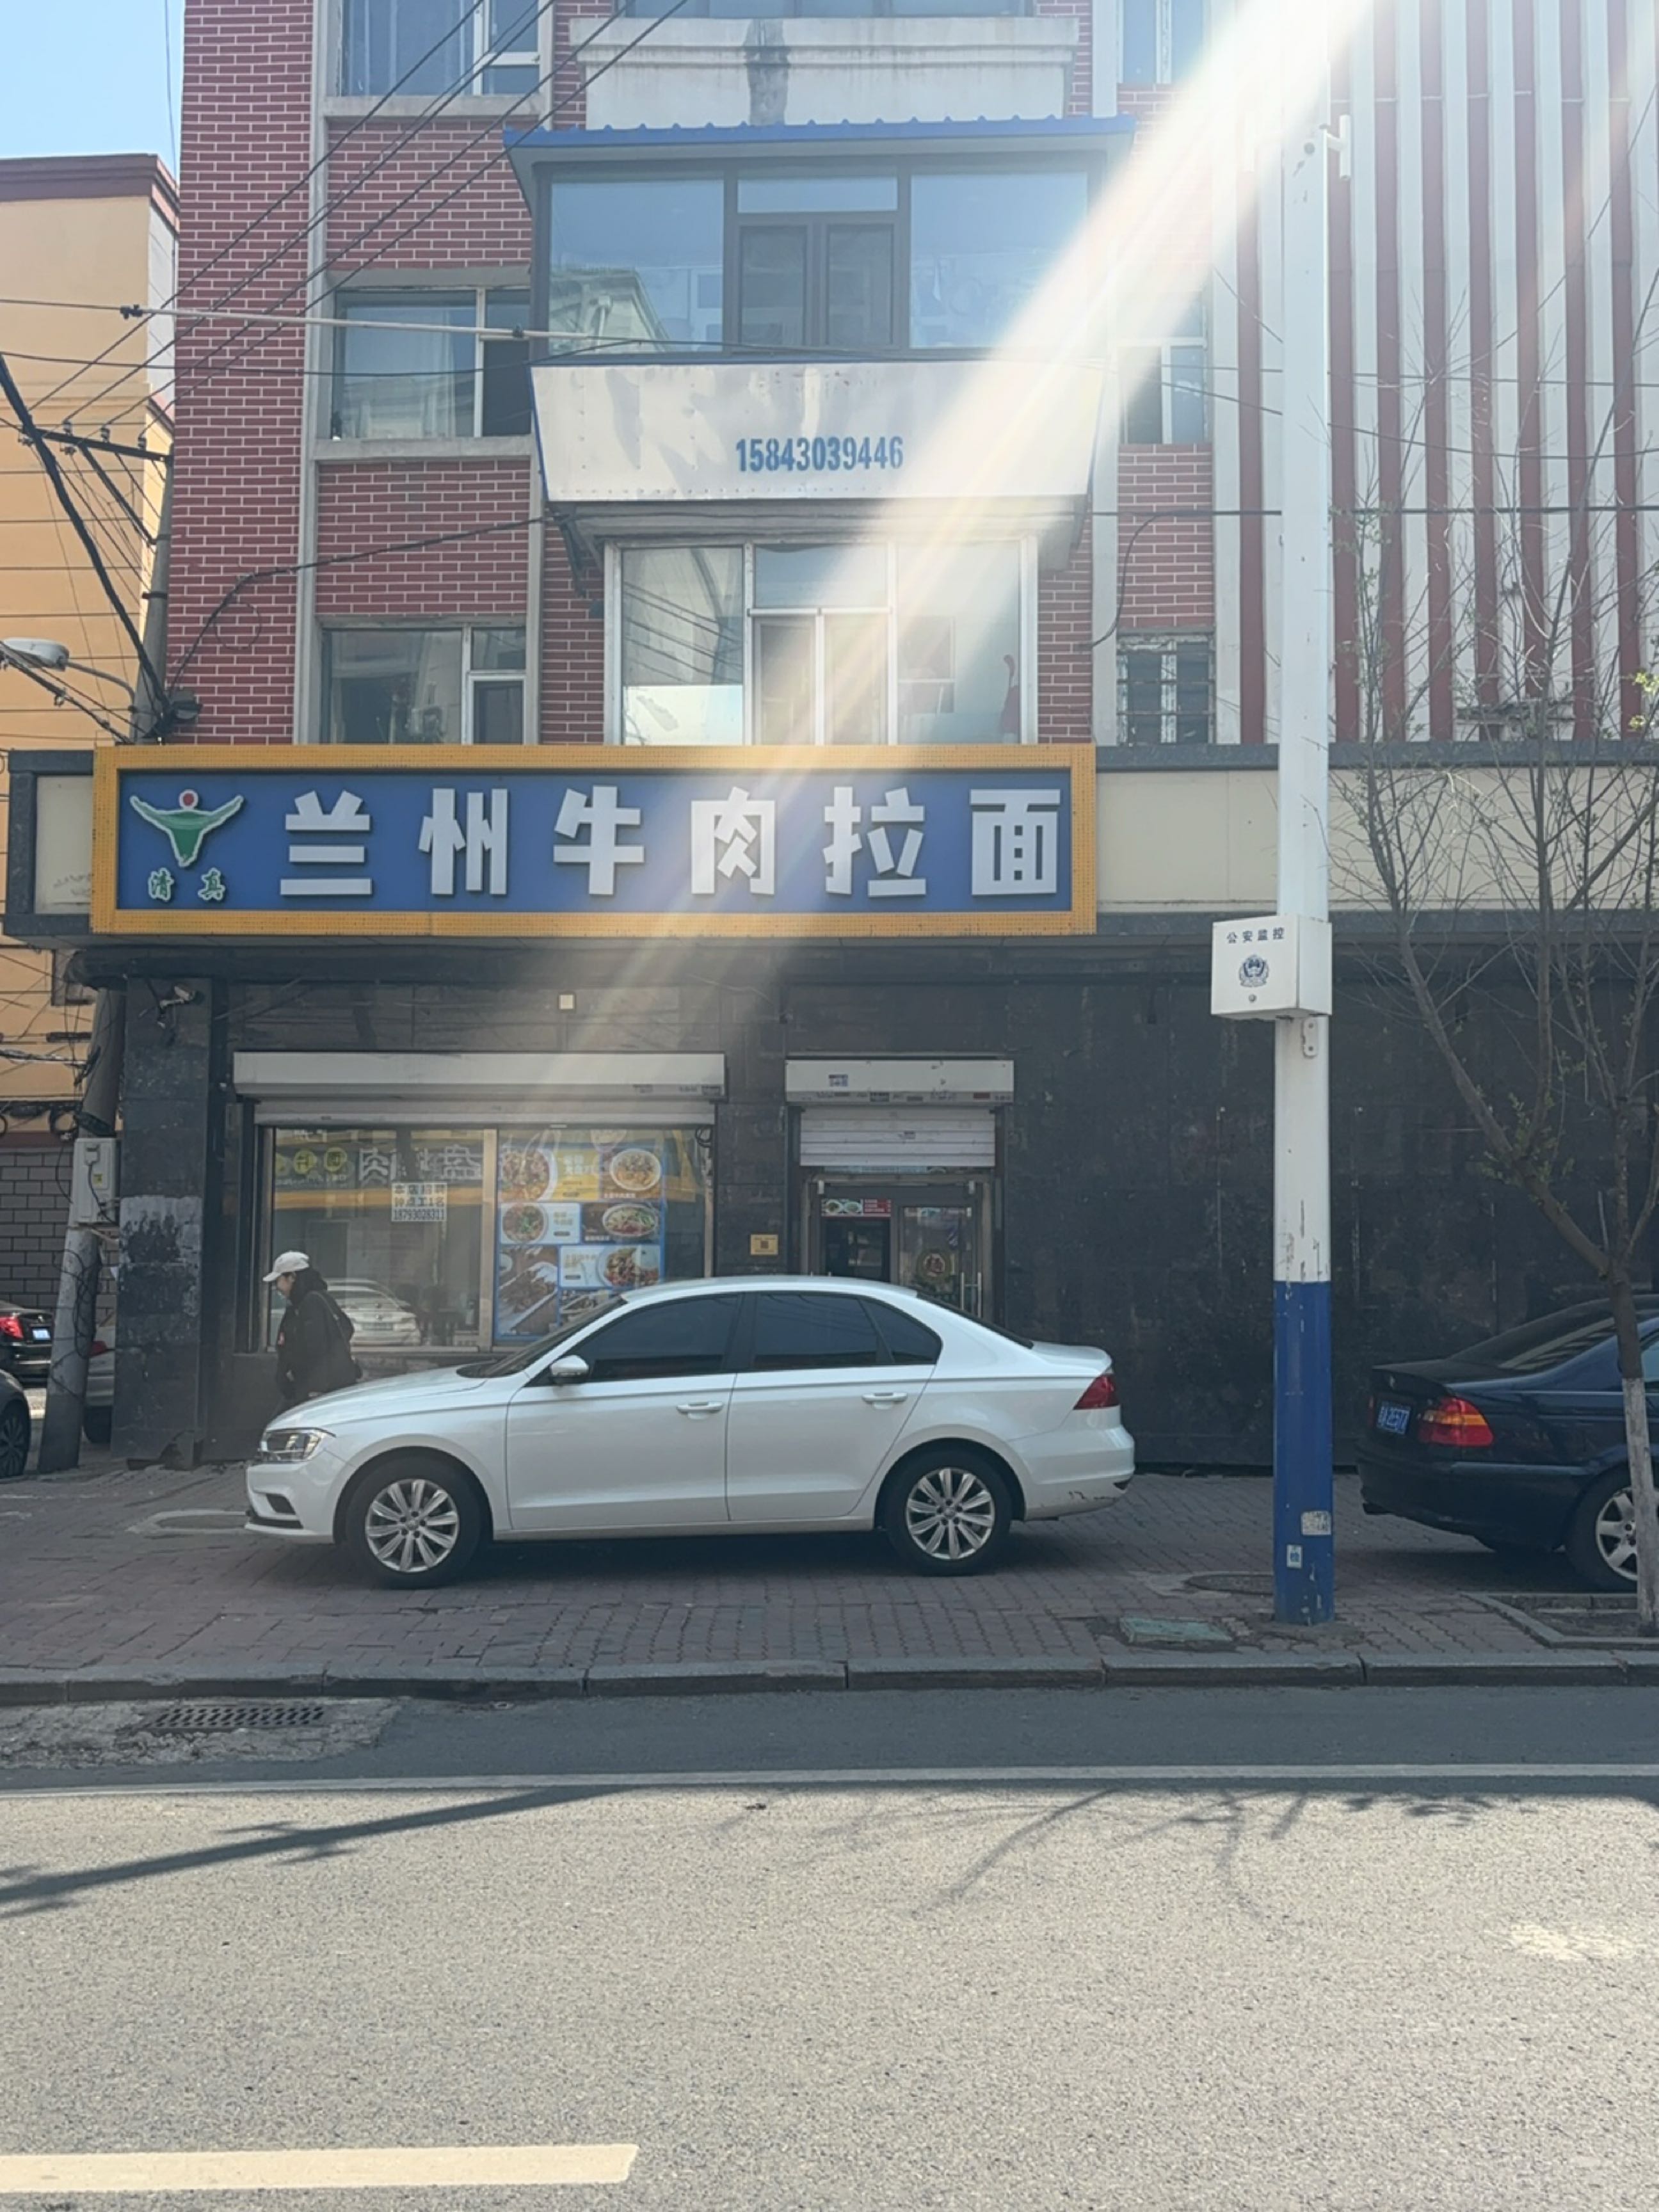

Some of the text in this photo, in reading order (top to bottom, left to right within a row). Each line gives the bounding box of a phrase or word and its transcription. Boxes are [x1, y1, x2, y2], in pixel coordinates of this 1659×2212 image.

[736, 437, 903, 472] 15843039446
[280, 785, 1062, 897] 兰州牛肉拉面
[148, 867, 226, 902] 清真
[1227, 927, 1285, 943] 公安监控
